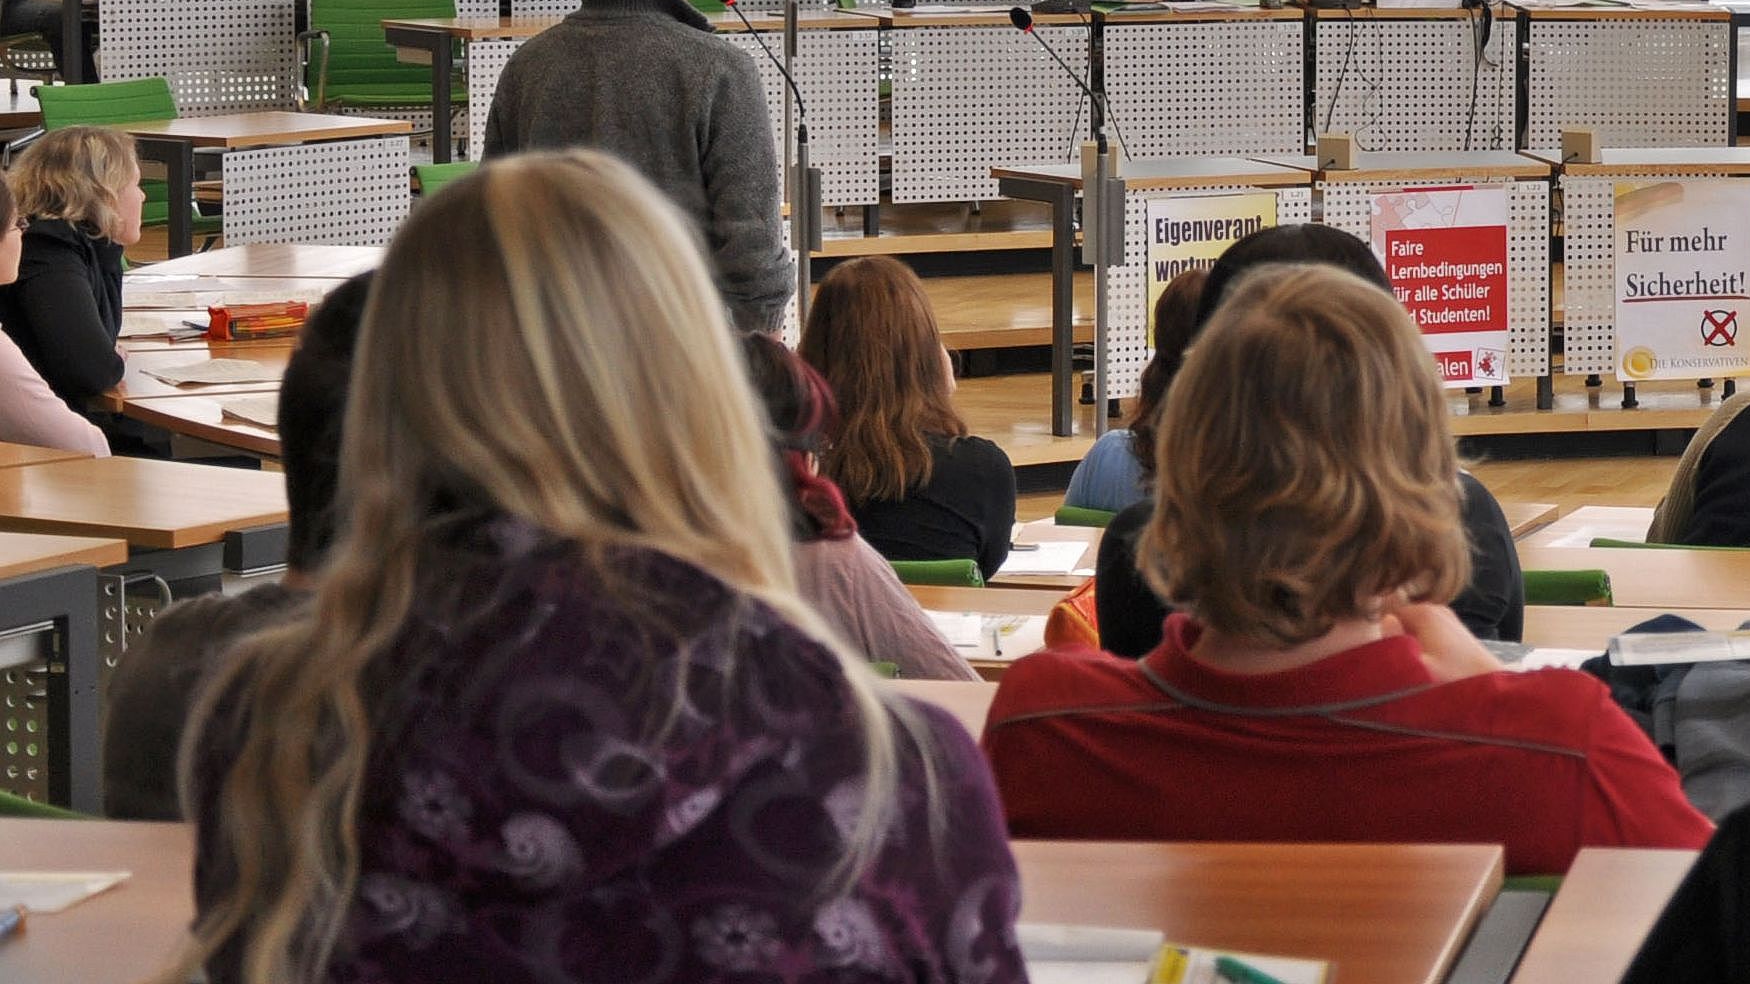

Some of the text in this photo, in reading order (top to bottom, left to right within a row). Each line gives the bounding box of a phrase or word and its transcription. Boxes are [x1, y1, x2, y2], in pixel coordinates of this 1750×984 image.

[1391, 240, 1424, 257] Faire
[1625, 227, 1728, 254] Für mehr
[1391, 262, 1503, 280] Lernbedingungen
[1414, 284, 1439, 302] alle
[1441, 283, 1491, 301] Schüler
[1625, 271, 1746, 298] Sicherheit!
[1419, 305, 1491, 325] Studenten!
